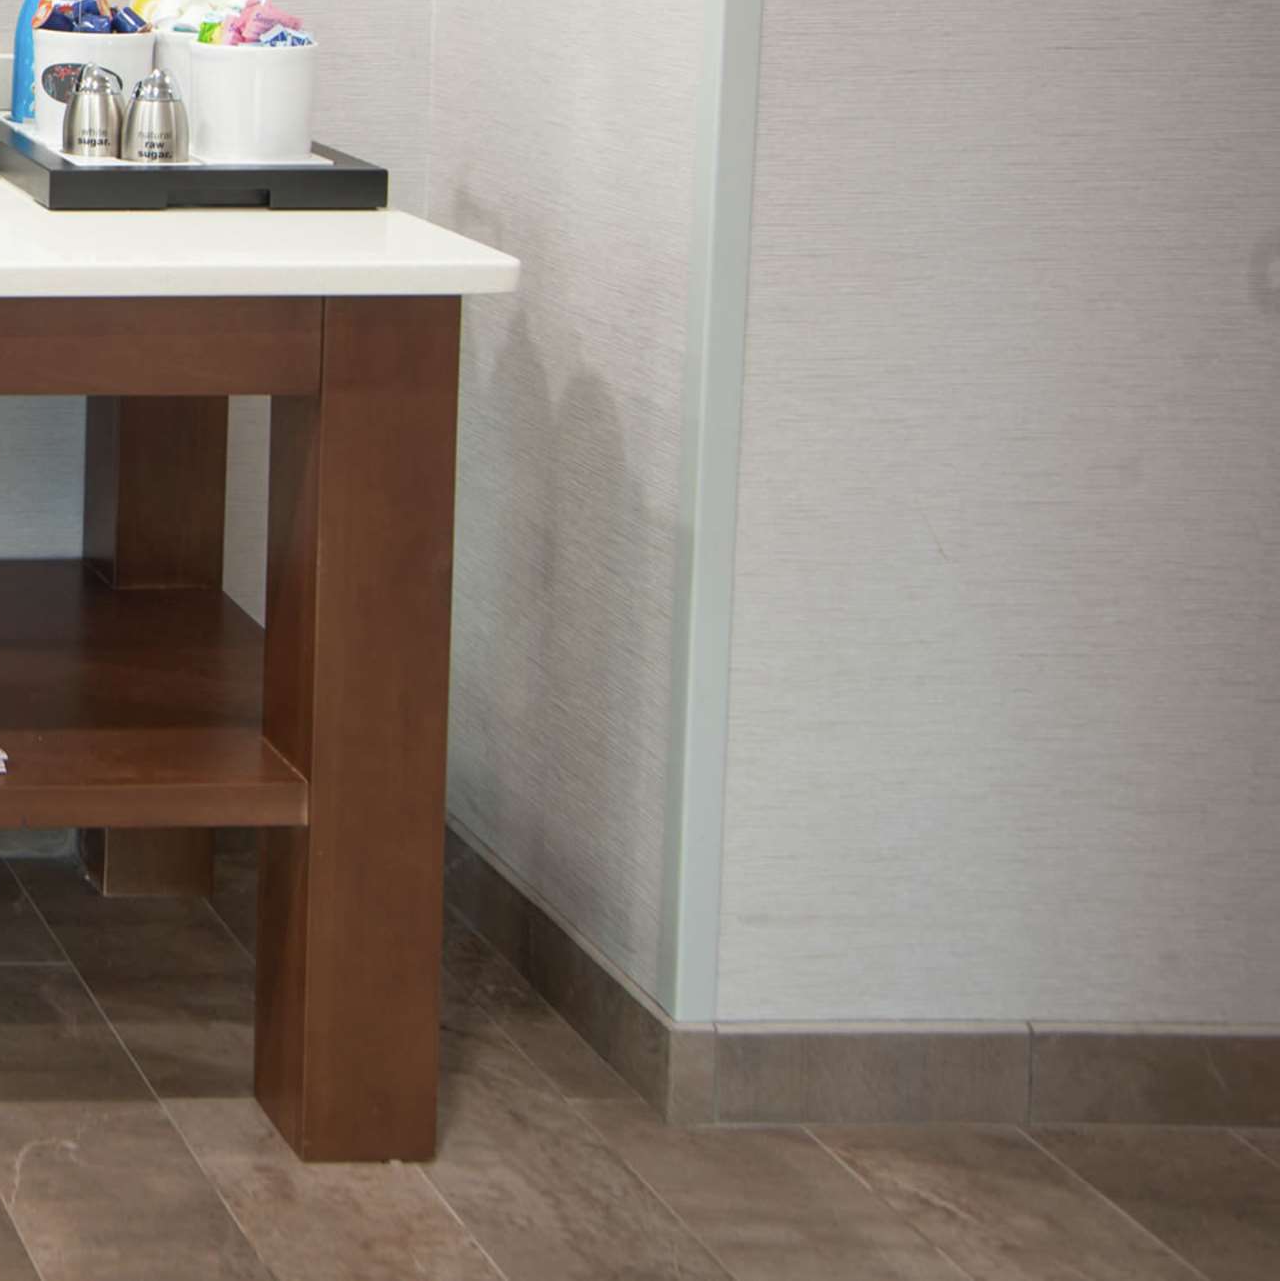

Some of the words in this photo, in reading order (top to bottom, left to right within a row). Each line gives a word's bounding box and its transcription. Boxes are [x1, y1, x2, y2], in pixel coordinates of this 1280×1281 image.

[77, 136, 111, 148] sugar.
[144, 140, 165, 150] raw
[137, 149, 173, 161] sugar.
